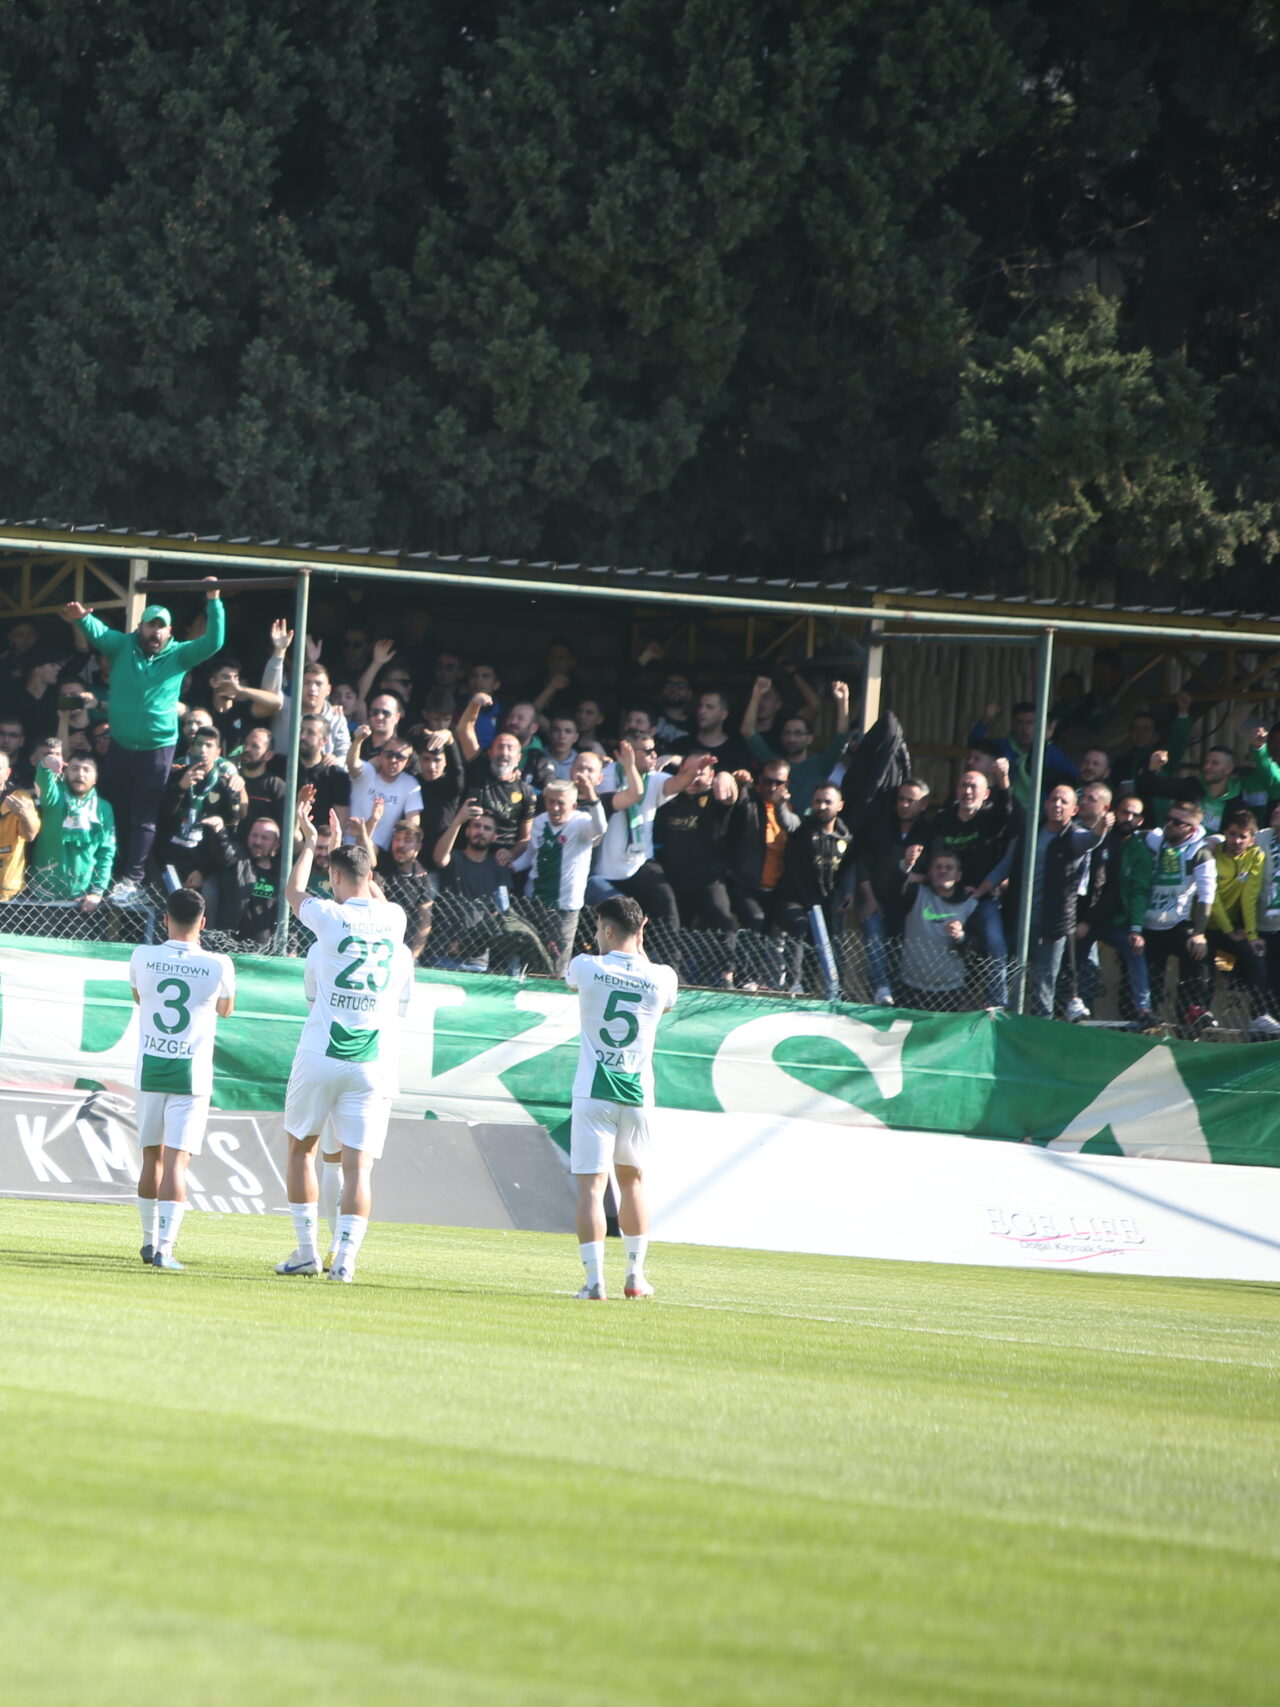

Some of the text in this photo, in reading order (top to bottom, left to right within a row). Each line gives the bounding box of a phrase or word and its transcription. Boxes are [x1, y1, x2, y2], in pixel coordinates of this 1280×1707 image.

[146, 961, 210, 977] MEDITOWN
[334, 935, 395, 993] 23
[593, 973, 659, 991] MEDITOWN
[152, 977, 191, 1035] 3
[599, 990, 642, 1049] 5
